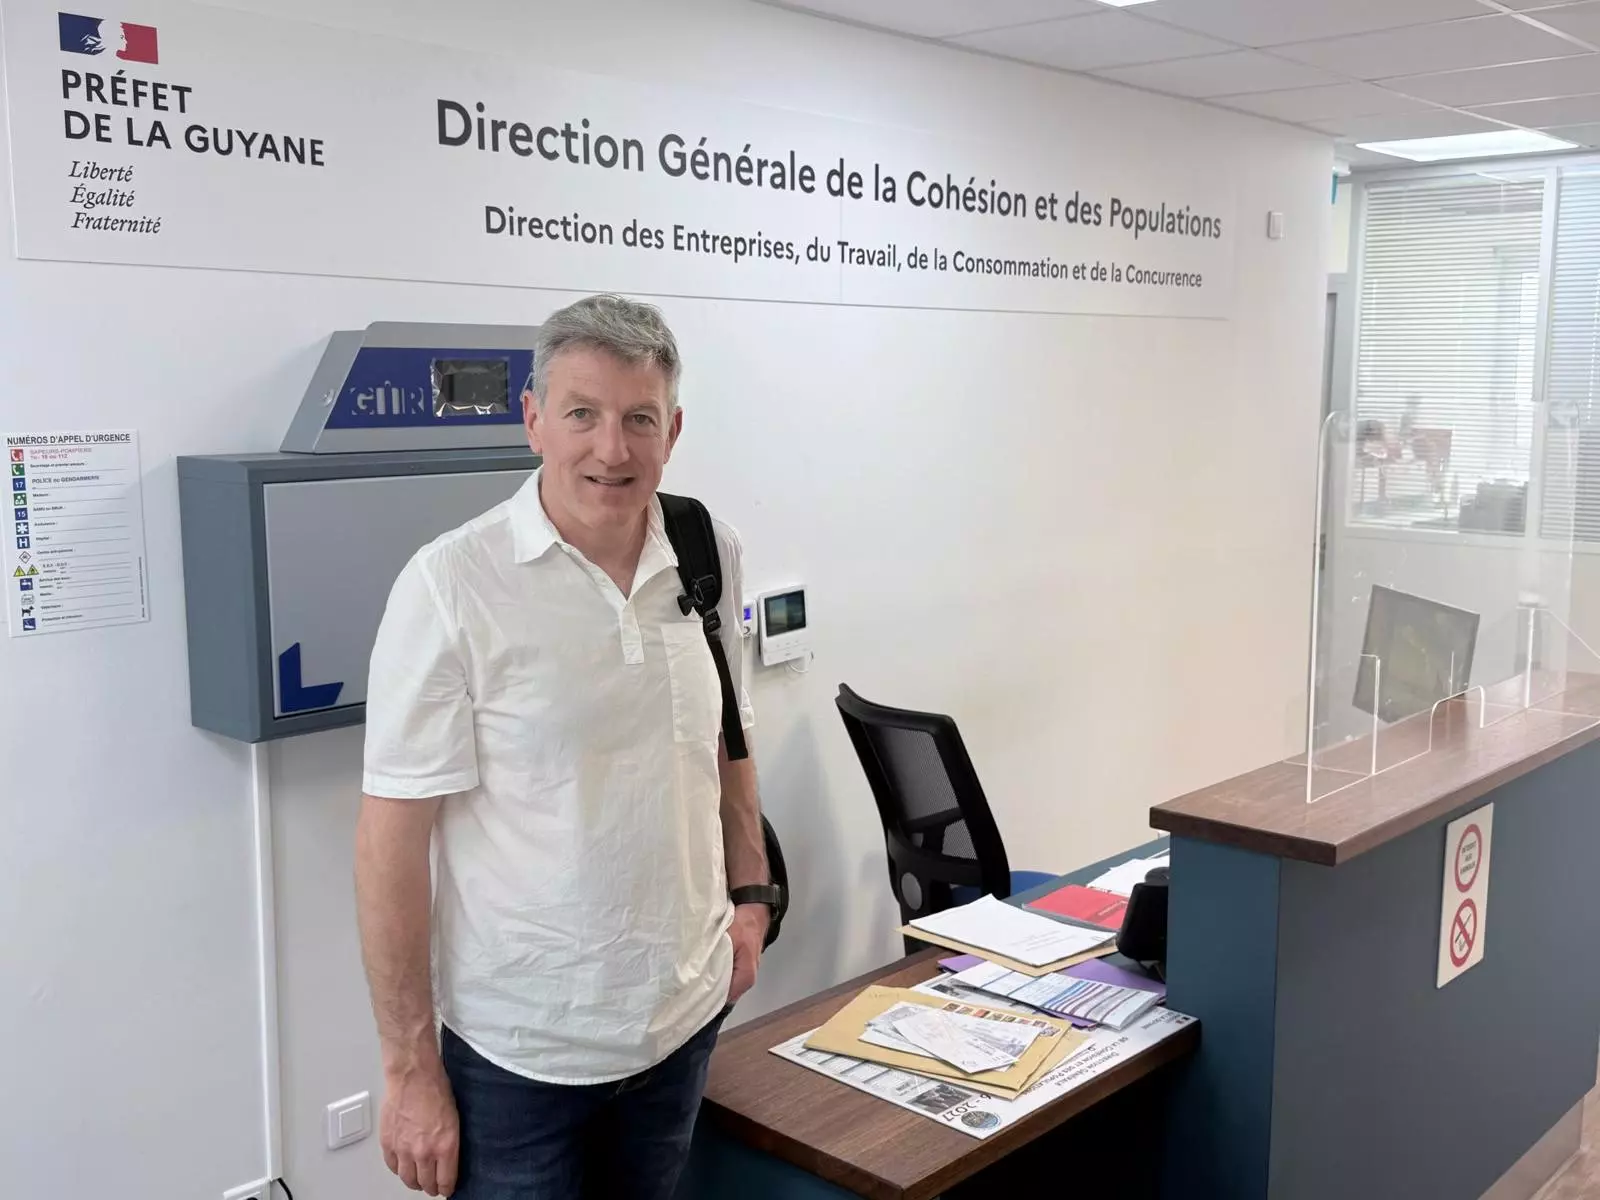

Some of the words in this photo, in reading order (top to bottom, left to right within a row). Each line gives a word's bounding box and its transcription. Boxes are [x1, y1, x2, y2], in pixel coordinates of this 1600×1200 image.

[61, 69, 193, 114] PRÉFET
[63, 109, 113, 144] DE
[126, 117, 172, 150] LA
[184, 124, 325, 167] GUYANE
[68, 160, 133, 183] Liberté
[437, 98, 644, 172] Direction
[658, 133, 816, 194] Générale
[826, 157, 863, 200] de
[874, 163, 896, 203] la
[906, 170, 1027, 218] Cohésion
[1034, 195, 1058, 222] et
[1065, 191, 1102, 226] des
[1110, 197, 1221, 240] Populations
[69, 185, 135, 209] Égalité
[71, 211, 161, 234] Fraternité
[485, 205, 613, 245] Direction
[622, 218, 665, 250] des
[673, 224, 800, 265] Entreprises,
[806, 236, 831, 263] du
[837, 240, 902, 272] Travail,
[907, 246, 928, 270] de
[934, 247, 947, 271] la
[953, 250, 1068, 279] Consommation
[1072, 263, 1087, 280] et
[1090, 262, 1107, 282] de
[1111, 262, 1122, 282] la
[1126, 264, 1202, 287] Concurrence
[7, 434, 49, 445] NUMÉROS
[50, 434, 84, 444] D'APPEL
[85, 433, 131, 443] D'URGENCE
[943, 1102, 978, 1122] 2027
